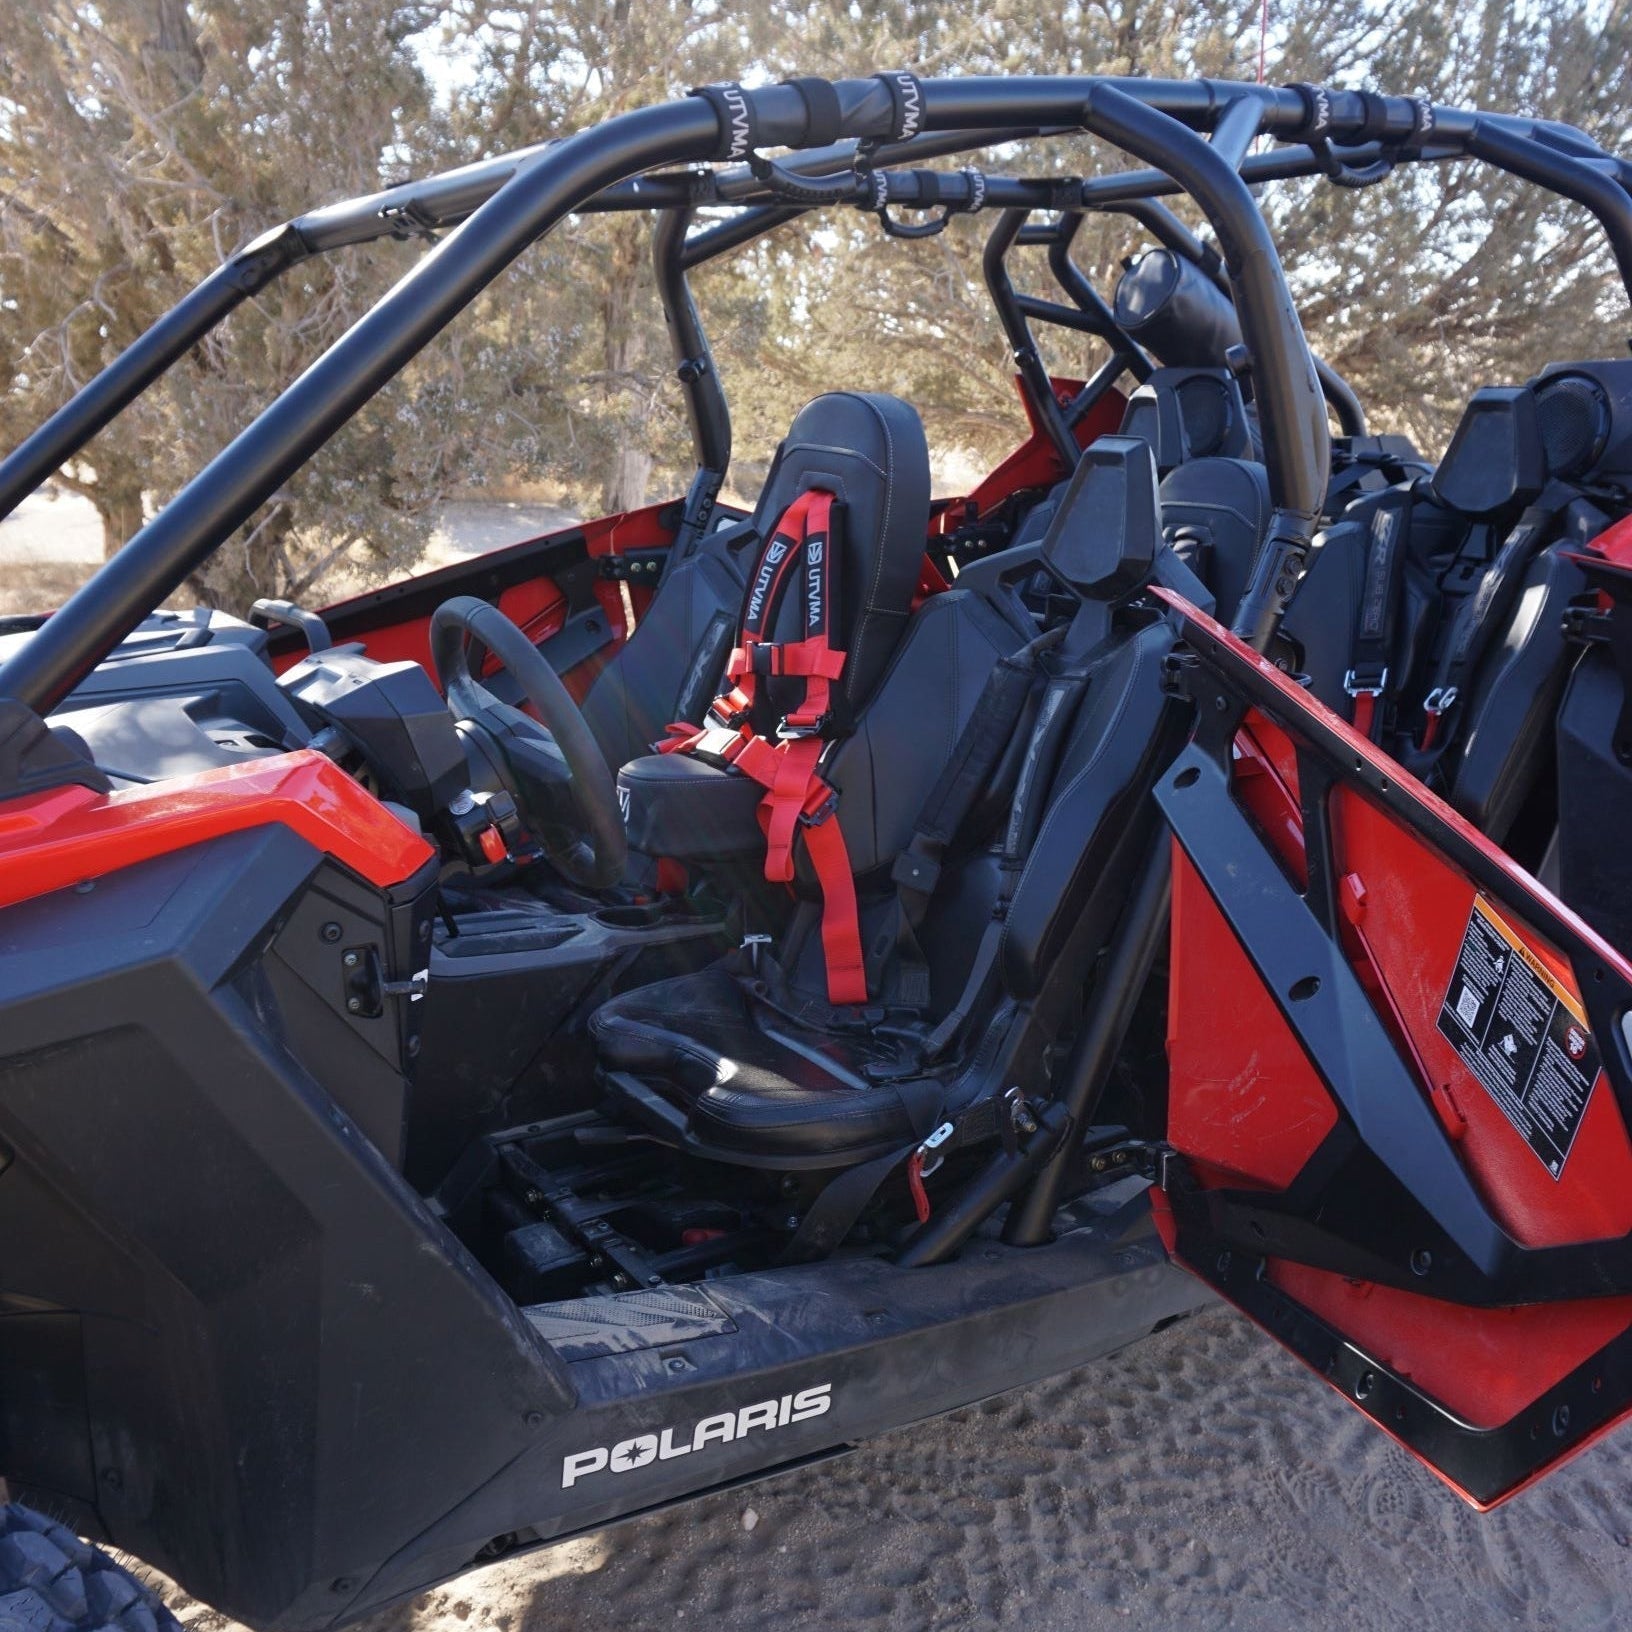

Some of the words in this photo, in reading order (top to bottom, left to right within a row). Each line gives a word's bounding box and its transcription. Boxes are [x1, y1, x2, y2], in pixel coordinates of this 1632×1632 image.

[723, 90, 749, 159] UTVMA
[897, 75, 921, 140] UTVMA
[747, 566, 774, 620] UTVMA
[808, 569, 821, 627] UTVMA
[1526, 952, 1555, 989] WARNING
[561, 1382, 832, 1489] POLARIS
